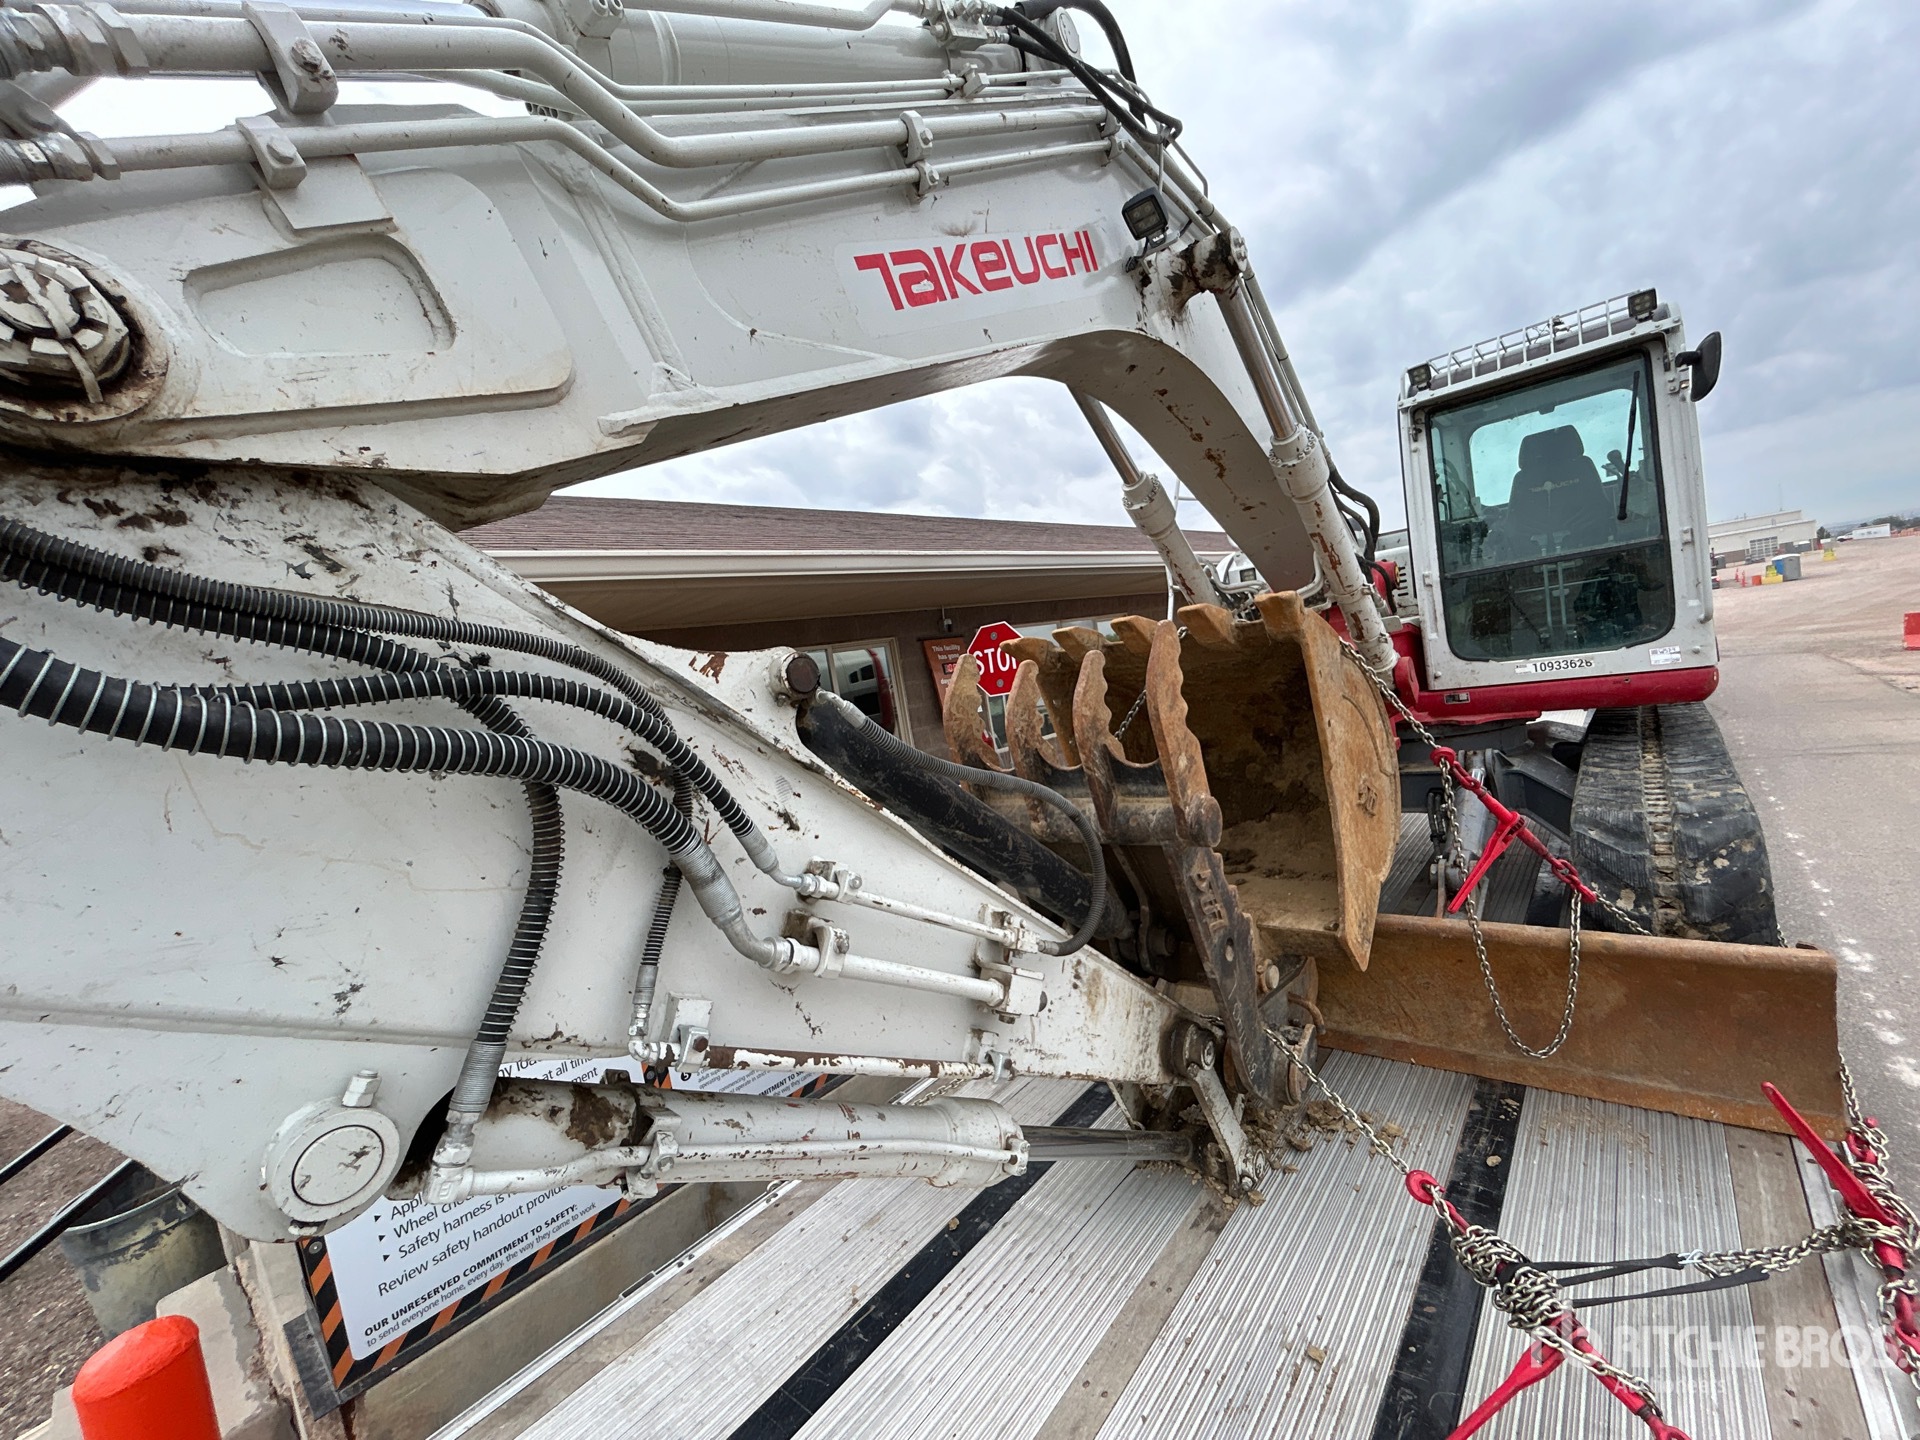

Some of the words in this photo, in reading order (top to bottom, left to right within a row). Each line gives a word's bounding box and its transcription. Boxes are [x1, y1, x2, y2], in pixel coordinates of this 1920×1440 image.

[555, 1060, 568, 1077] all
[788, 1073, 795, 1082] TO
[391, 1192, 428, 1221] Appl
[394, 1205, 438, 1239] Wheel
[399, 1228, 440, 1259] Safety
[443, 1200, 493, 1234] harness
[495, 1192, 505, 1205] is
[364, 1317, 389, 1337] OUR
[391, 1274, 461, 1321] UNRESERVED
[463, 1232, 530, 1278] COMMITMENT
[531, 1225, 543, 1237] TO
[544, 1203, 578, 1229] SAFETY:
[367, 1337, 377, 1347] to
[378, 1321, 401, 1341] send
[401, 1299, 440, 1327] everyone
[440, 1284, 466, 1303] home,
[467, 1270, 488, 1287] every
[489, 1259, 505, 1273] day,
[505, 1250, 518, 1262] the
[518, 1241, 535, 1254] way
[535, 1232, 551, 1245] they
[551, 1219, 571, 1234] came
[571, 1213, 579, 1222] to
[580, 1202, 597, 1217] work
[378, 1260, 429, 1297] Review
[432, 1237, 470, 1266] safety
[473, 1204, 525, 1242] handout
